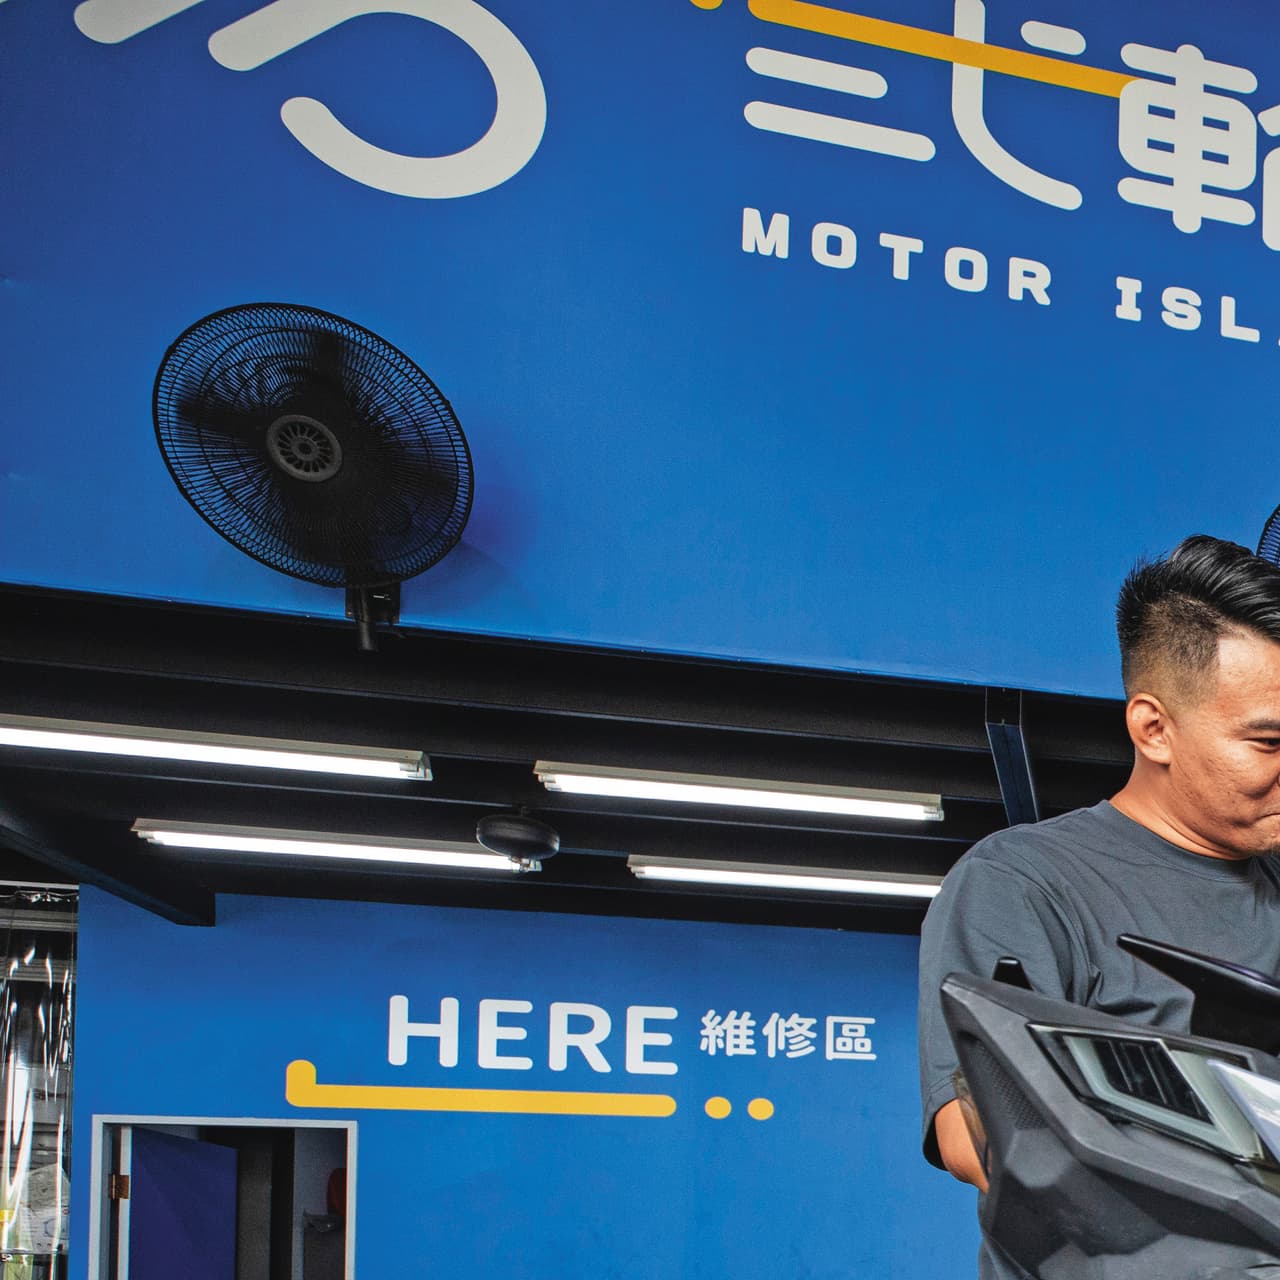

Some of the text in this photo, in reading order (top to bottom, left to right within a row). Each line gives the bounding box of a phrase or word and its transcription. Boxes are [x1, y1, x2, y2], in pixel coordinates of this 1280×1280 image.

[742, 207, 1052, 307] MOTOR
[388, 994, 679, 1076] HERE
[699, 1009, 878, 1061] 維修區
